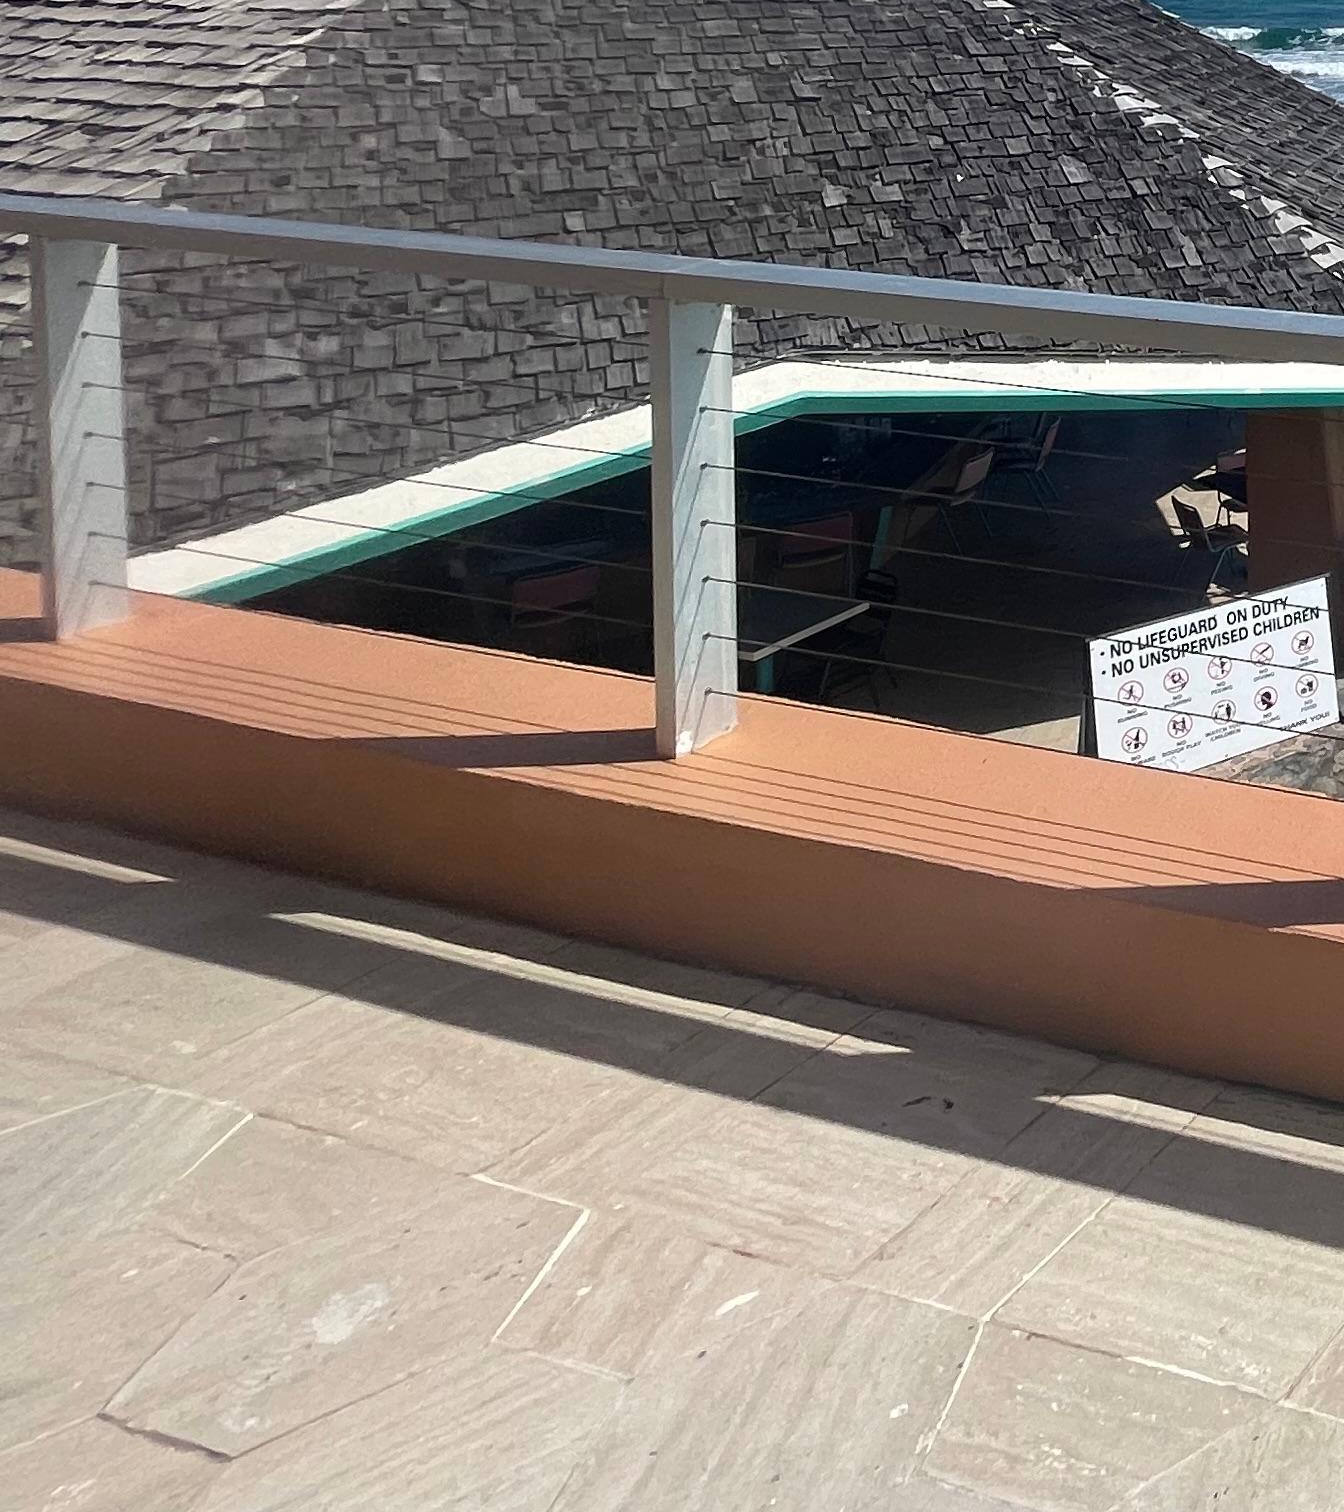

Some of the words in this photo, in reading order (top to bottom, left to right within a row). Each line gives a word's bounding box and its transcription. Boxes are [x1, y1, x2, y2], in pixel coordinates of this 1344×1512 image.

[1110, 641, 1132, 658] NO
[1138, 616, 1218, 650] LIFEGUARD
[1226, 608, 1247, 625] ON
[1252, 596, 1288, 619] DUTY
[1112, 659, 1134, 677] NO
[1139, 627, 1248, 669] UNSUPERVISED
[1253, 606, 1320, 636] CHILDREN
